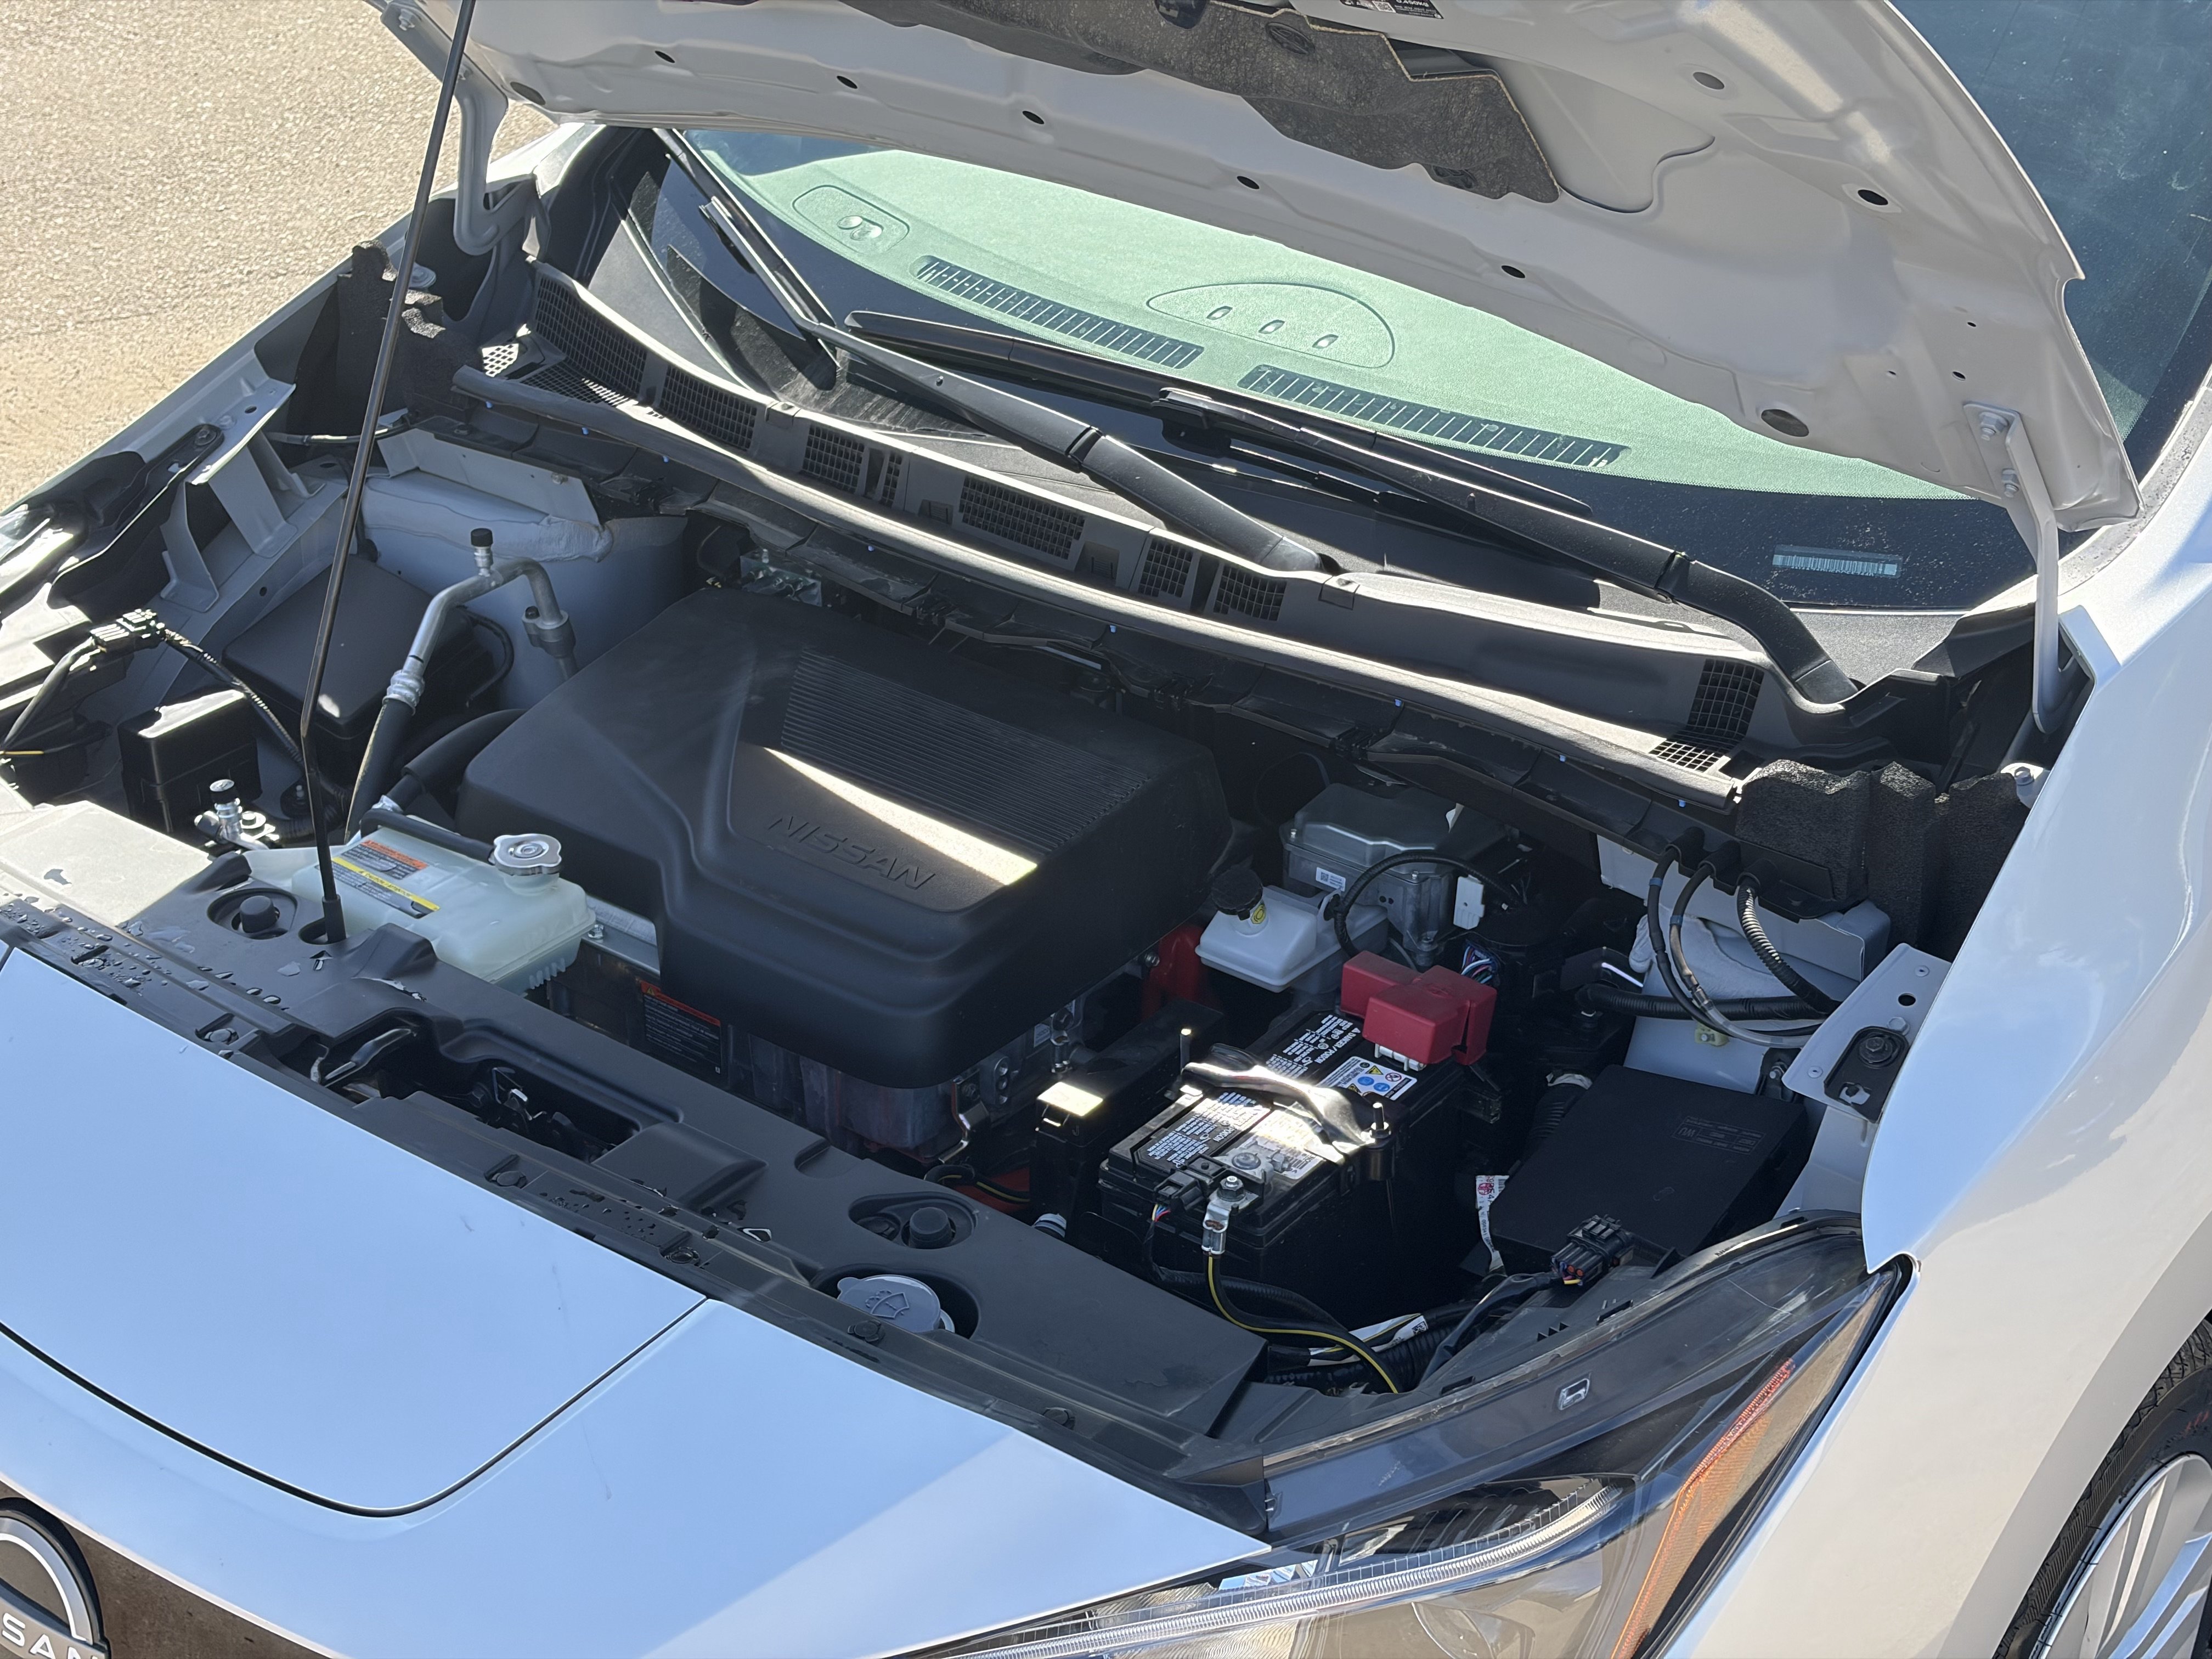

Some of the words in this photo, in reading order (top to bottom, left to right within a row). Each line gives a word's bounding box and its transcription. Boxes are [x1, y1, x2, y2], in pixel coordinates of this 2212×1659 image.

[767, 815, 936, 890] NISSAN
[1336, 1032, 1357, 1048] DANGER
[1314, 1048, 1335, 1064] POISON
[1212, 1127, 1235, 1142] POISON
[2, 1612, 98, 1659] SA
